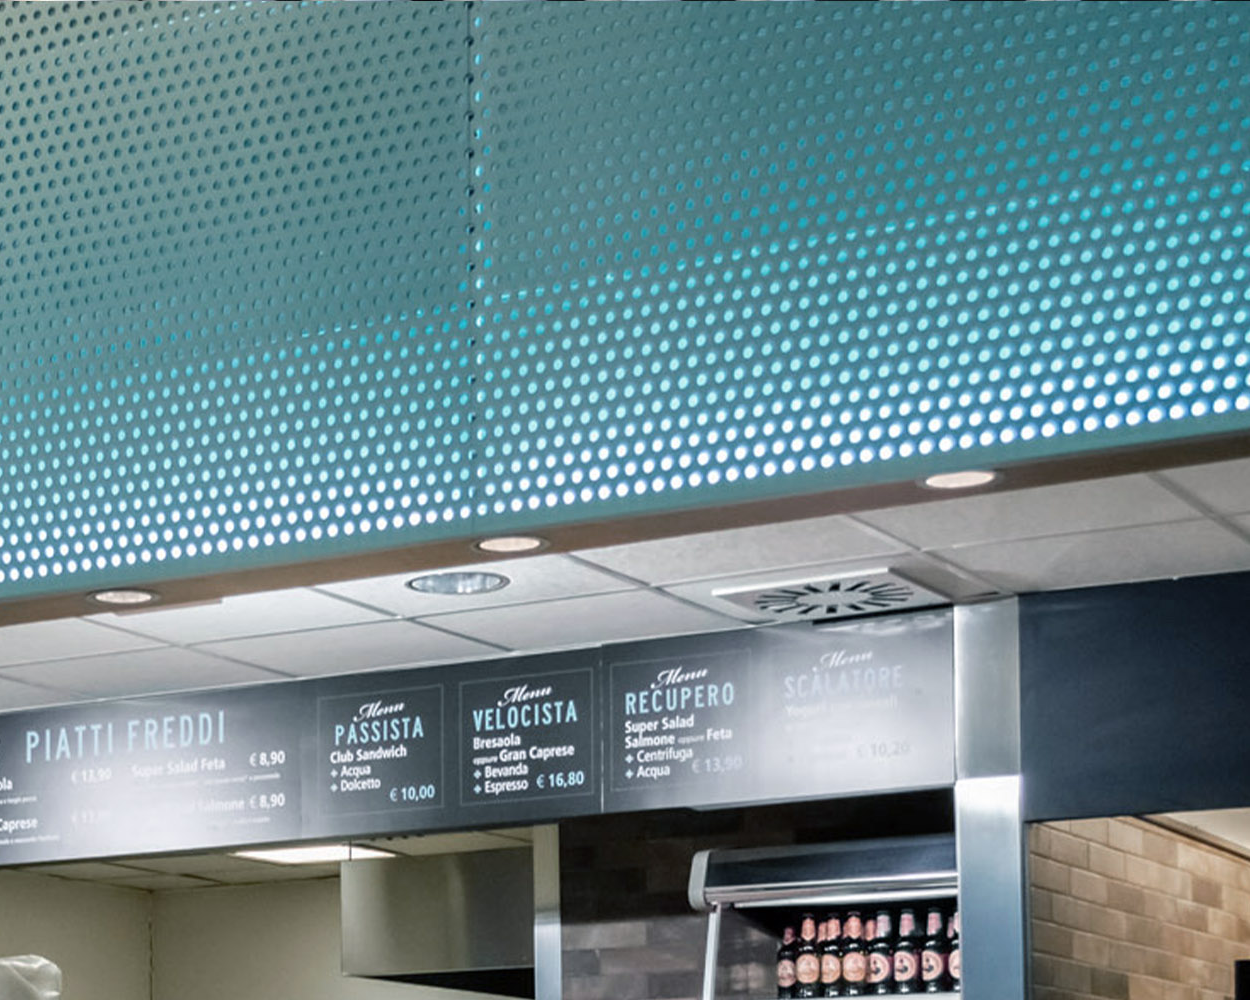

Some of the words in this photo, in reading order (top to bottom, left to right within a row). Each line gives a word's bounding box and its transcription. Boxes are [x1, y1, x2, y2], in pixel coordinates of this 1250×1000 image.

[650, 666, 708, 689] Menu
[497, 684, 553, 707] Menu
[625, 682, 734, 715] RECUPERO
[353, 700, 404, 722] Menu
[473, 700, 578, 732] VELOCISTA
[335, 716, 424, 746] PASSISTA
[625, 720, 658, 735] Super
[662, 713, 694, 730] Salad
[26, 722, 113, 763] PIATTI
[127, 711, 224, 751] FREDDI
[473, 733, 521, 750] Bresaola
[625, 733, 675, 749] Salmone
[706, 728, 733, 741] Feta
[200, 757, 226, 771] Feta
[259, 750, 285, 767] 8,90
[330, 750, 353, 763] Club
[356, 744, 407, 761] Sandwich
[499, 749, 526, 762] Gran
[529, 745, 575, 761] Caprese
[637, 747, 693, 762] Centrifuga
[340, 765, 371, 778] Acqua
[485, 762, 529, 778] Bevanda
[637, 765, 670, 779] Acqua
[340, 779, 381, 792] Dolcetto
[401, 784, 435, 802] 10,00
[485, 780, 529, 795] Espresso
[549, 771, 585, 788] 16,80
[259, 793, 285, 809] 8,90
